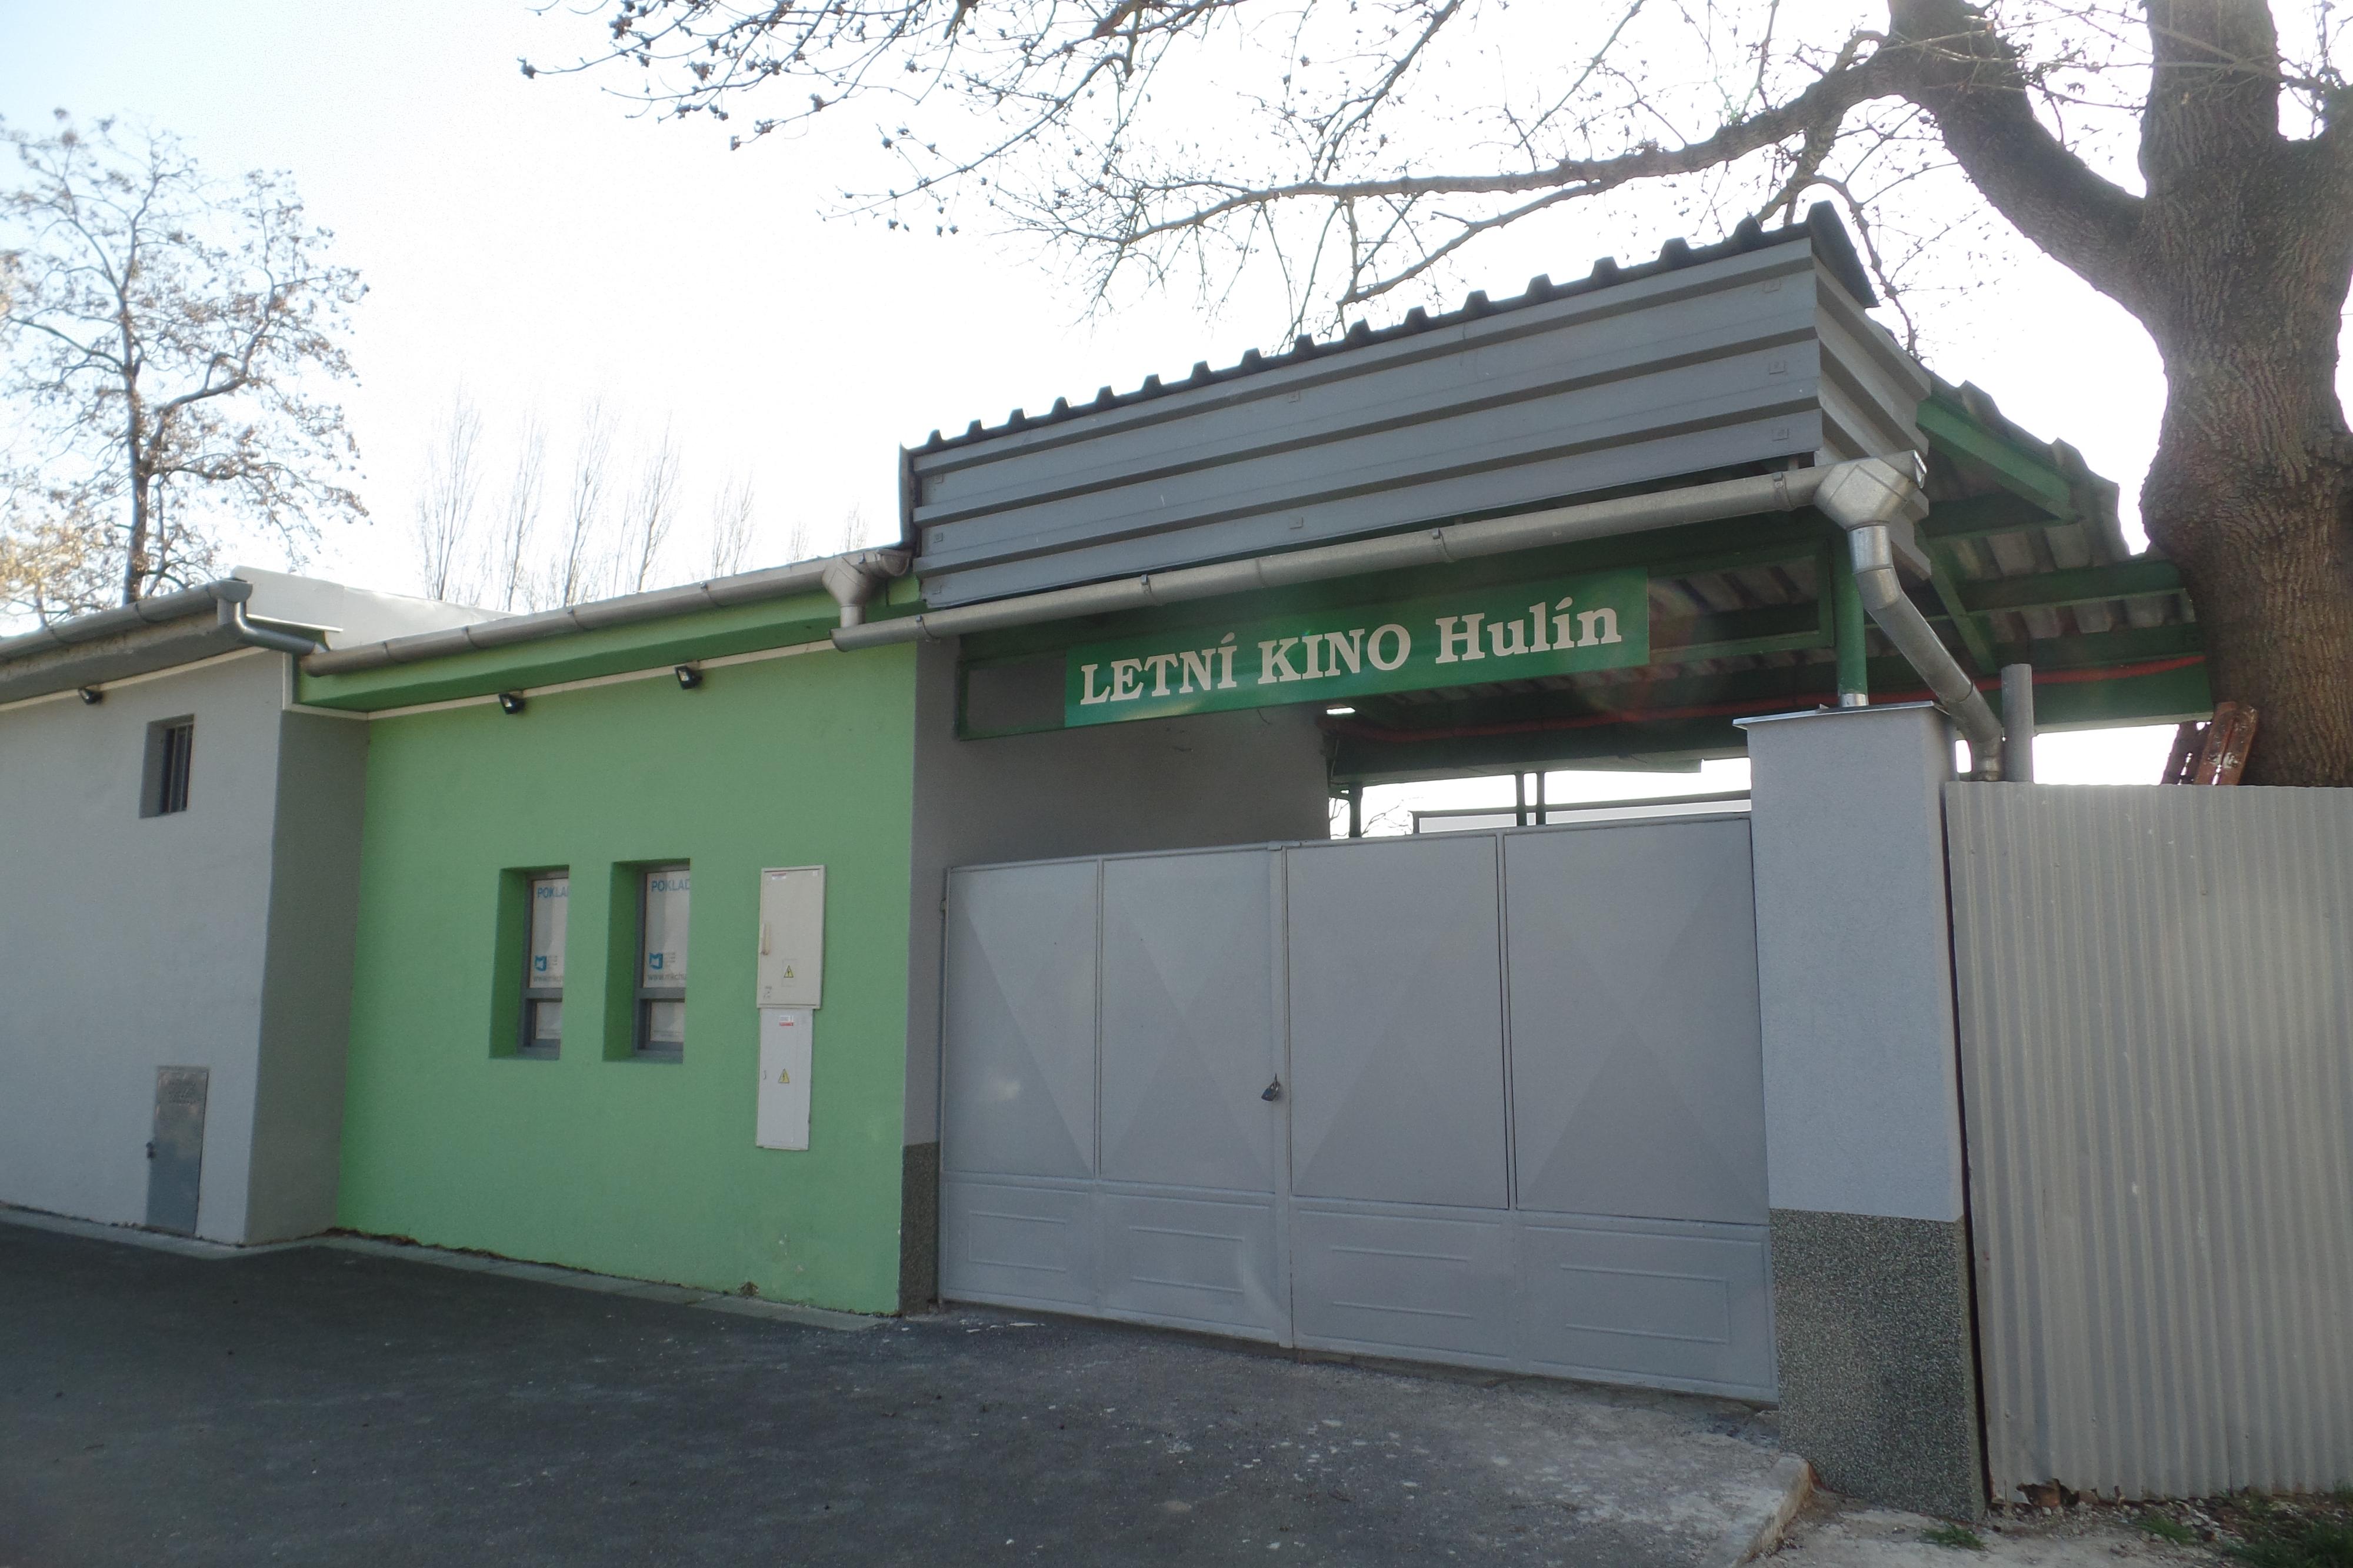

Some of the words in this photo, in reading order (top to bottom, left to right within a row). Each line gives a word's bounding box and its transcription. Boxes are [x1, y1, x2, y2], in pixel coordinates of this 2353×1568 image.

[1080, 632, 1237, 705] LETNÍ
[1258, 624, 1411, 684] KINO
[1435, 597, 1621, 663] Hulín
